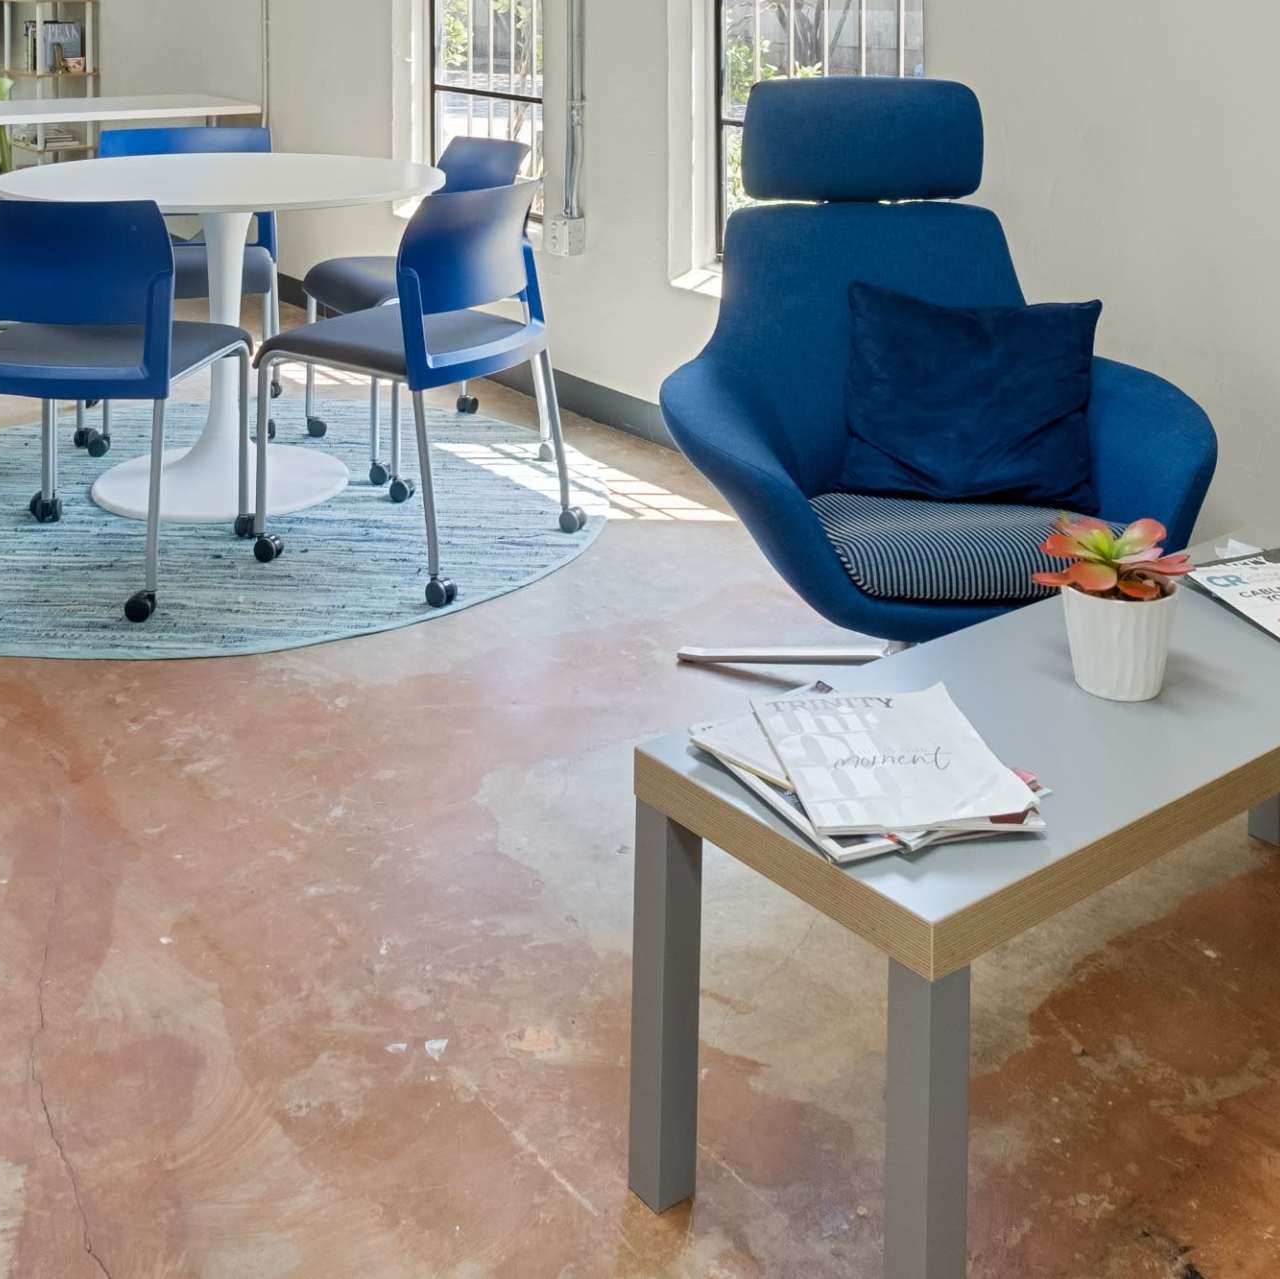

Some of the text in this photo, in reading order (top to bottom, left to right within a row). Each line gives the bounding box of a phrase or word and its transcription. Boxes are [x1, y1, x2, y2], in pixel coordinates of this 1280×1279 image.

[47, 24, 79, 41] PEAK
[1206, 574, 1249, 587] CR
[766, 697, 895, 713] TRINITY
